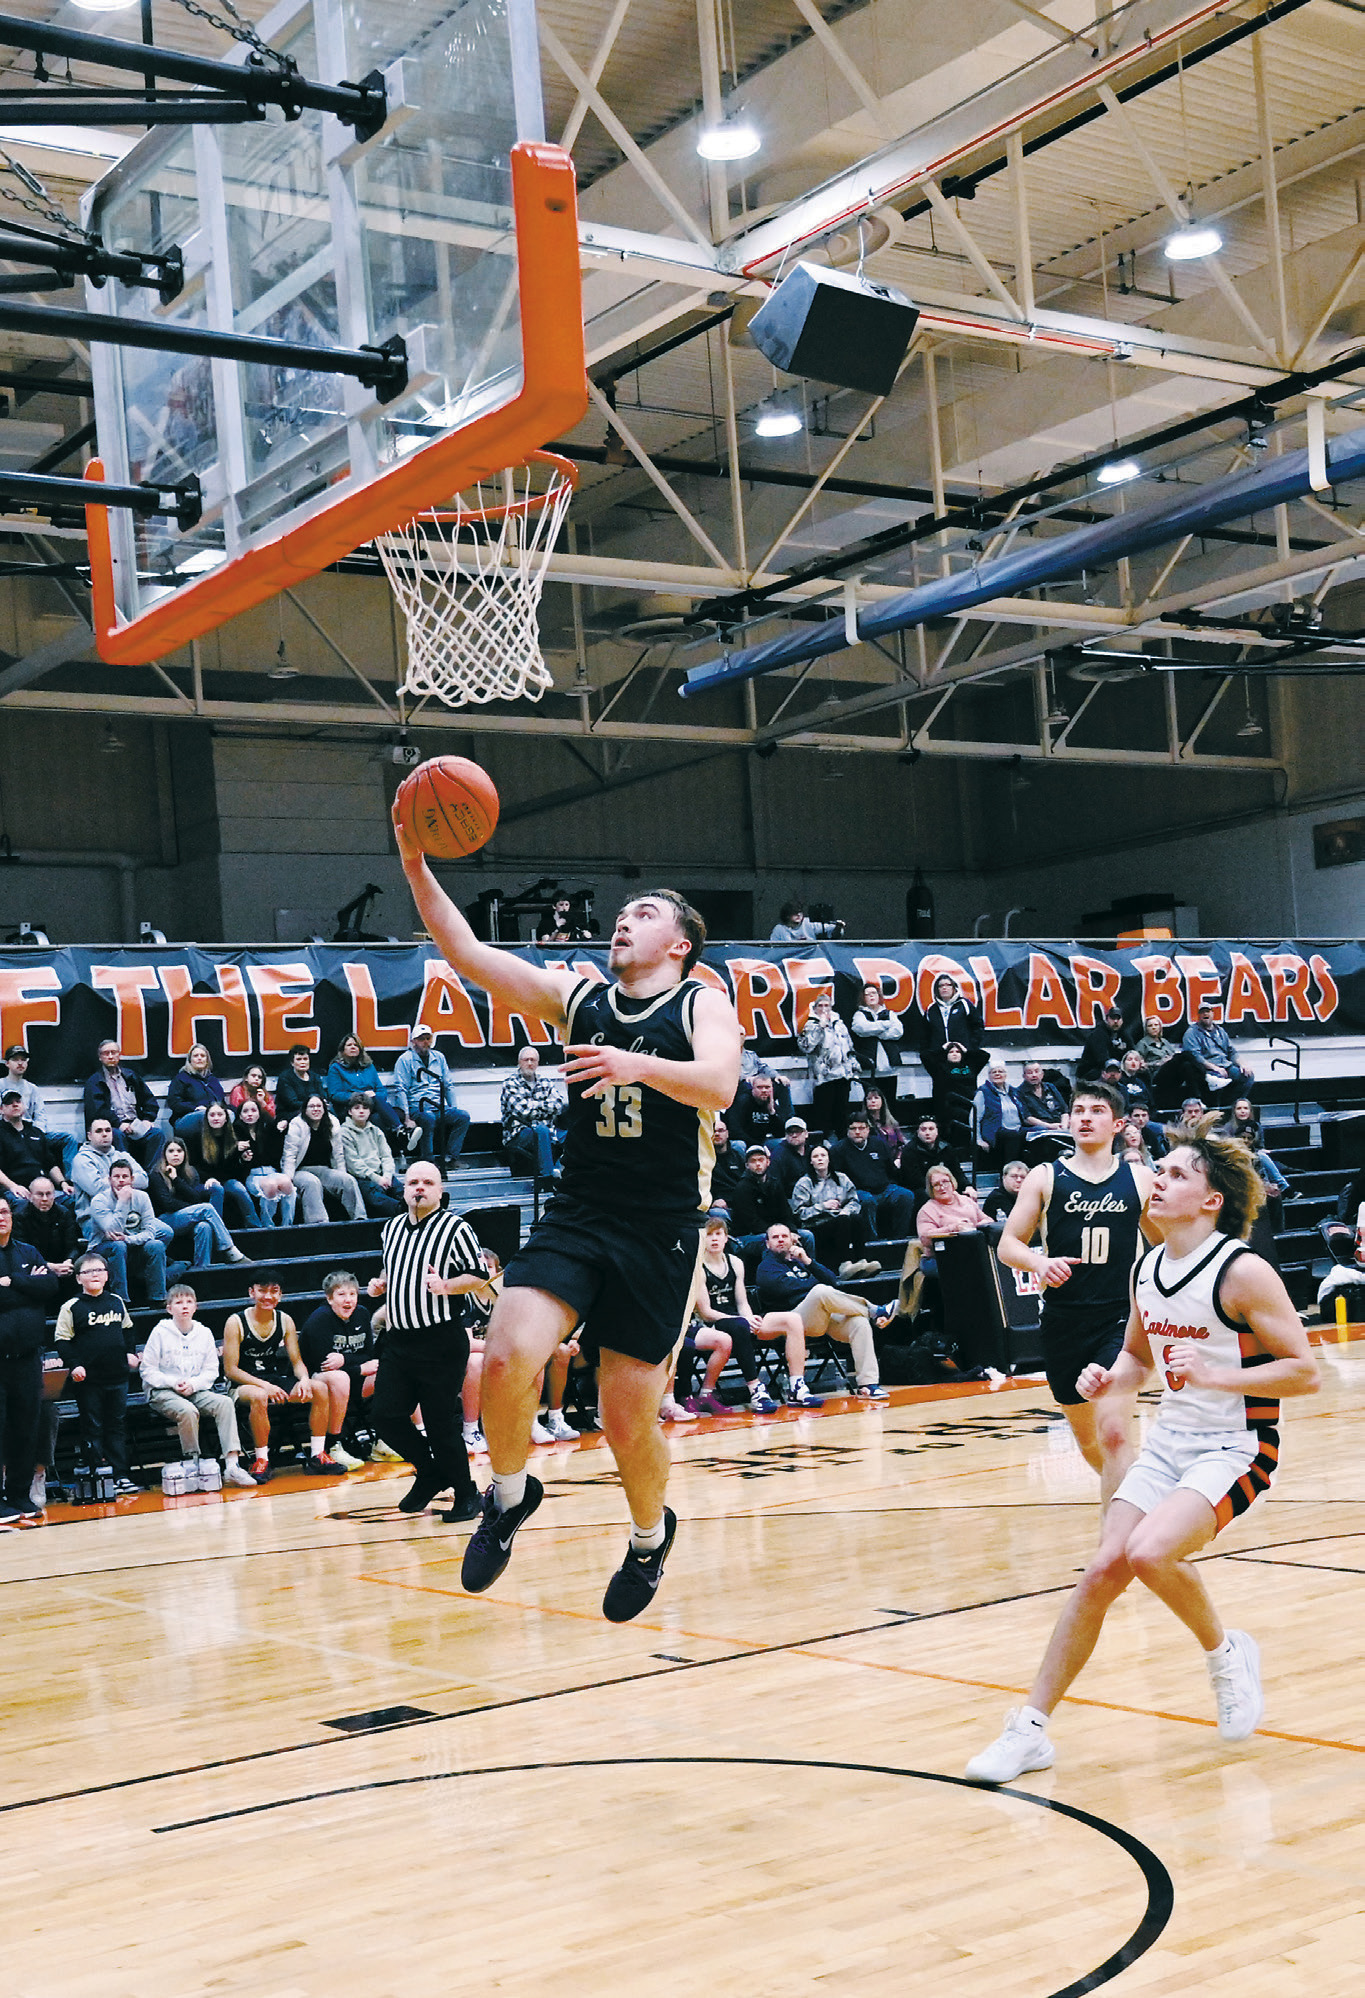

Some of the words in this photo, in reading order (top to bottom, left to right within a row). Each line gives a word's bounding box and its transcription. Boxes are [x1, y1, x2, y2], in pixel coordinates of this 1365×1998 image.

[90, 964, 321, 1060] THE
[1130, 952, 1339, 1027] BEARS
[594, 1086, 643, 1138] 33
[1064, 1191, 1128, 1221] Eagles
[1081, 1227, 1110, 1264] 10
